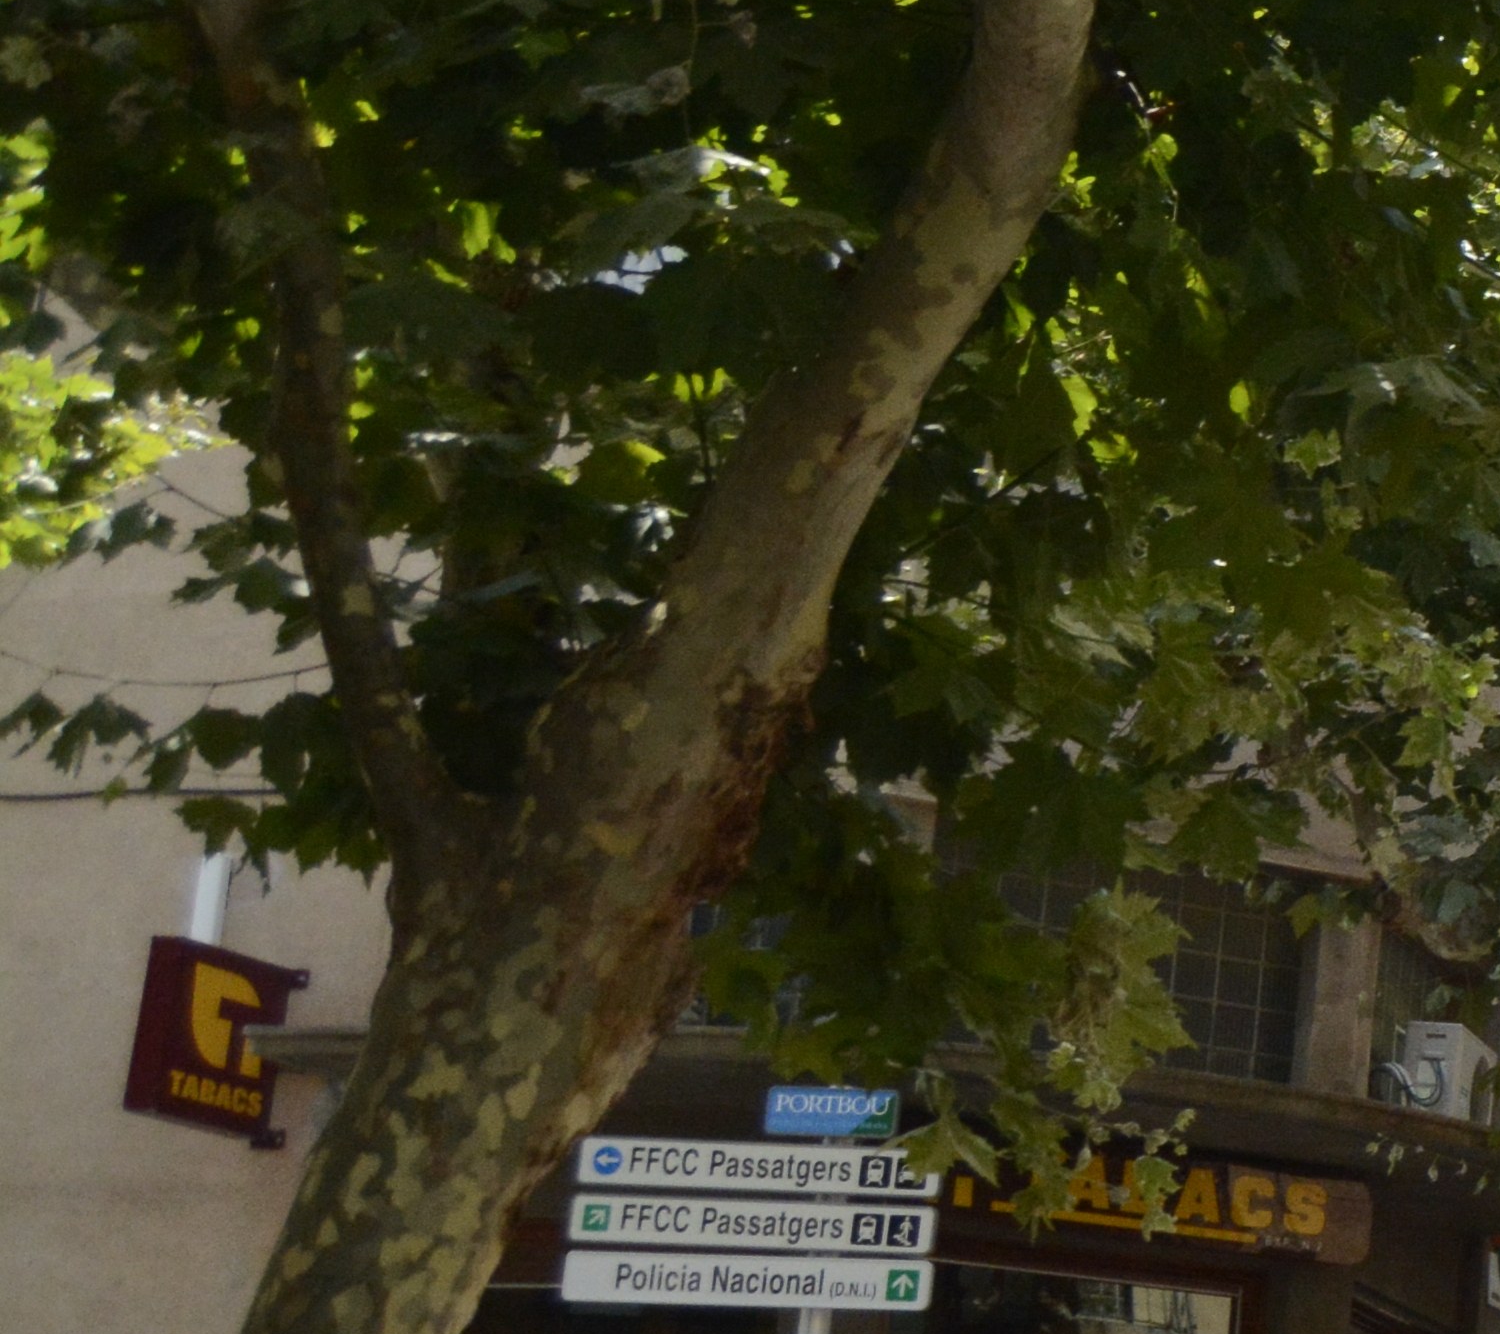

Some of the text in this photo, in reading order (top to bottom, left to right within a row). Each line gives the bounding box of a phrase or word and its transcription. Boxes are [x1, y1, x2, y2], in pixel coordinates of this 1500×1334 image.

[170, 1070, 263, 1117] TABACS
[775, 1094, 890, 1116] PORTBOU
[629, 1147, 851, 1187] FFCC Passatgers
[621, 1204, 843, 1244] FFCC Passatgers
[615, 1263, 877, 1299] Policia Nacional (D.N.I.)
